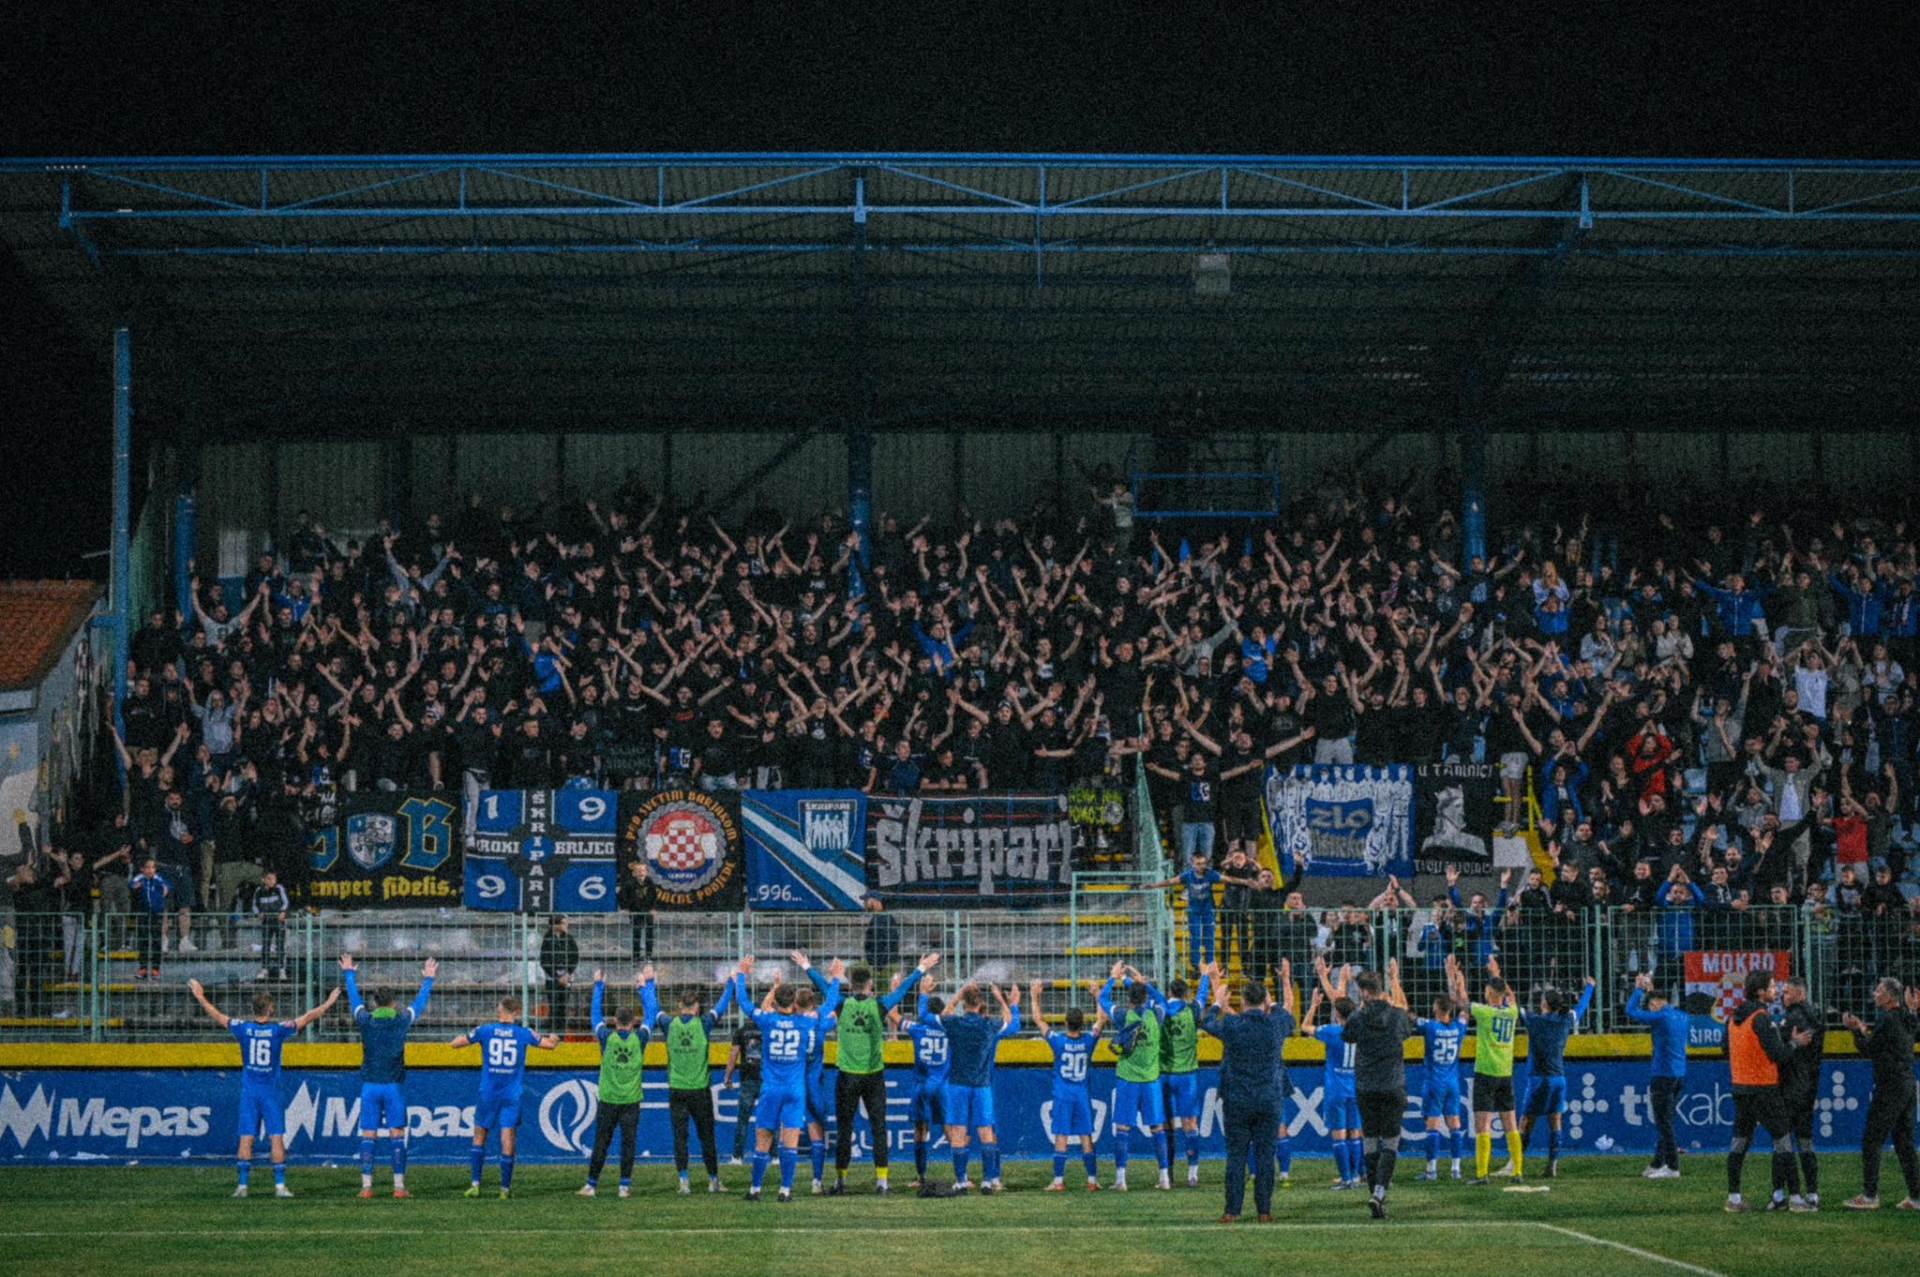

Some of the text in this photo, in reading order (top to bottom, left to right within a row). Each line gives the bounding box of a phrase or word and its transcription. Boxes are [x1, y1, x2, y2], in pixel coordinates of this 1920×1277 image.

[484, 794, 499, 820] 1
[578, 796, 606, 821] 9
[397, 797, 456, 872] B
[476, 839, 615, 855] ROKI BRIJEG
[876, 793, 1073, 895] Škripari
[310, 875, 457, 900] emper fidelis.
[476, 875, 506, 898] 9
[578, 876, 607, 900] 6
[1702, 952, 1776, 974] MOKRO
[769, 1029, 801, 1056] 22
[1491, 1016, 1514, 1043] 40
[1689, 1024, 1723, 1044] ŠIRO
[249, 1038, 271, 1066] 16
[488, 1038, 518, 1066] 95
[919, 1037, 949, 1062] 24
[1433, 1037, 1459, 1064] 25
[1060, 1052, 1088, 1081] 20
[56, 1098, 211, 1148] Mepas
[321, 1096, 478, 1149] Mpas
